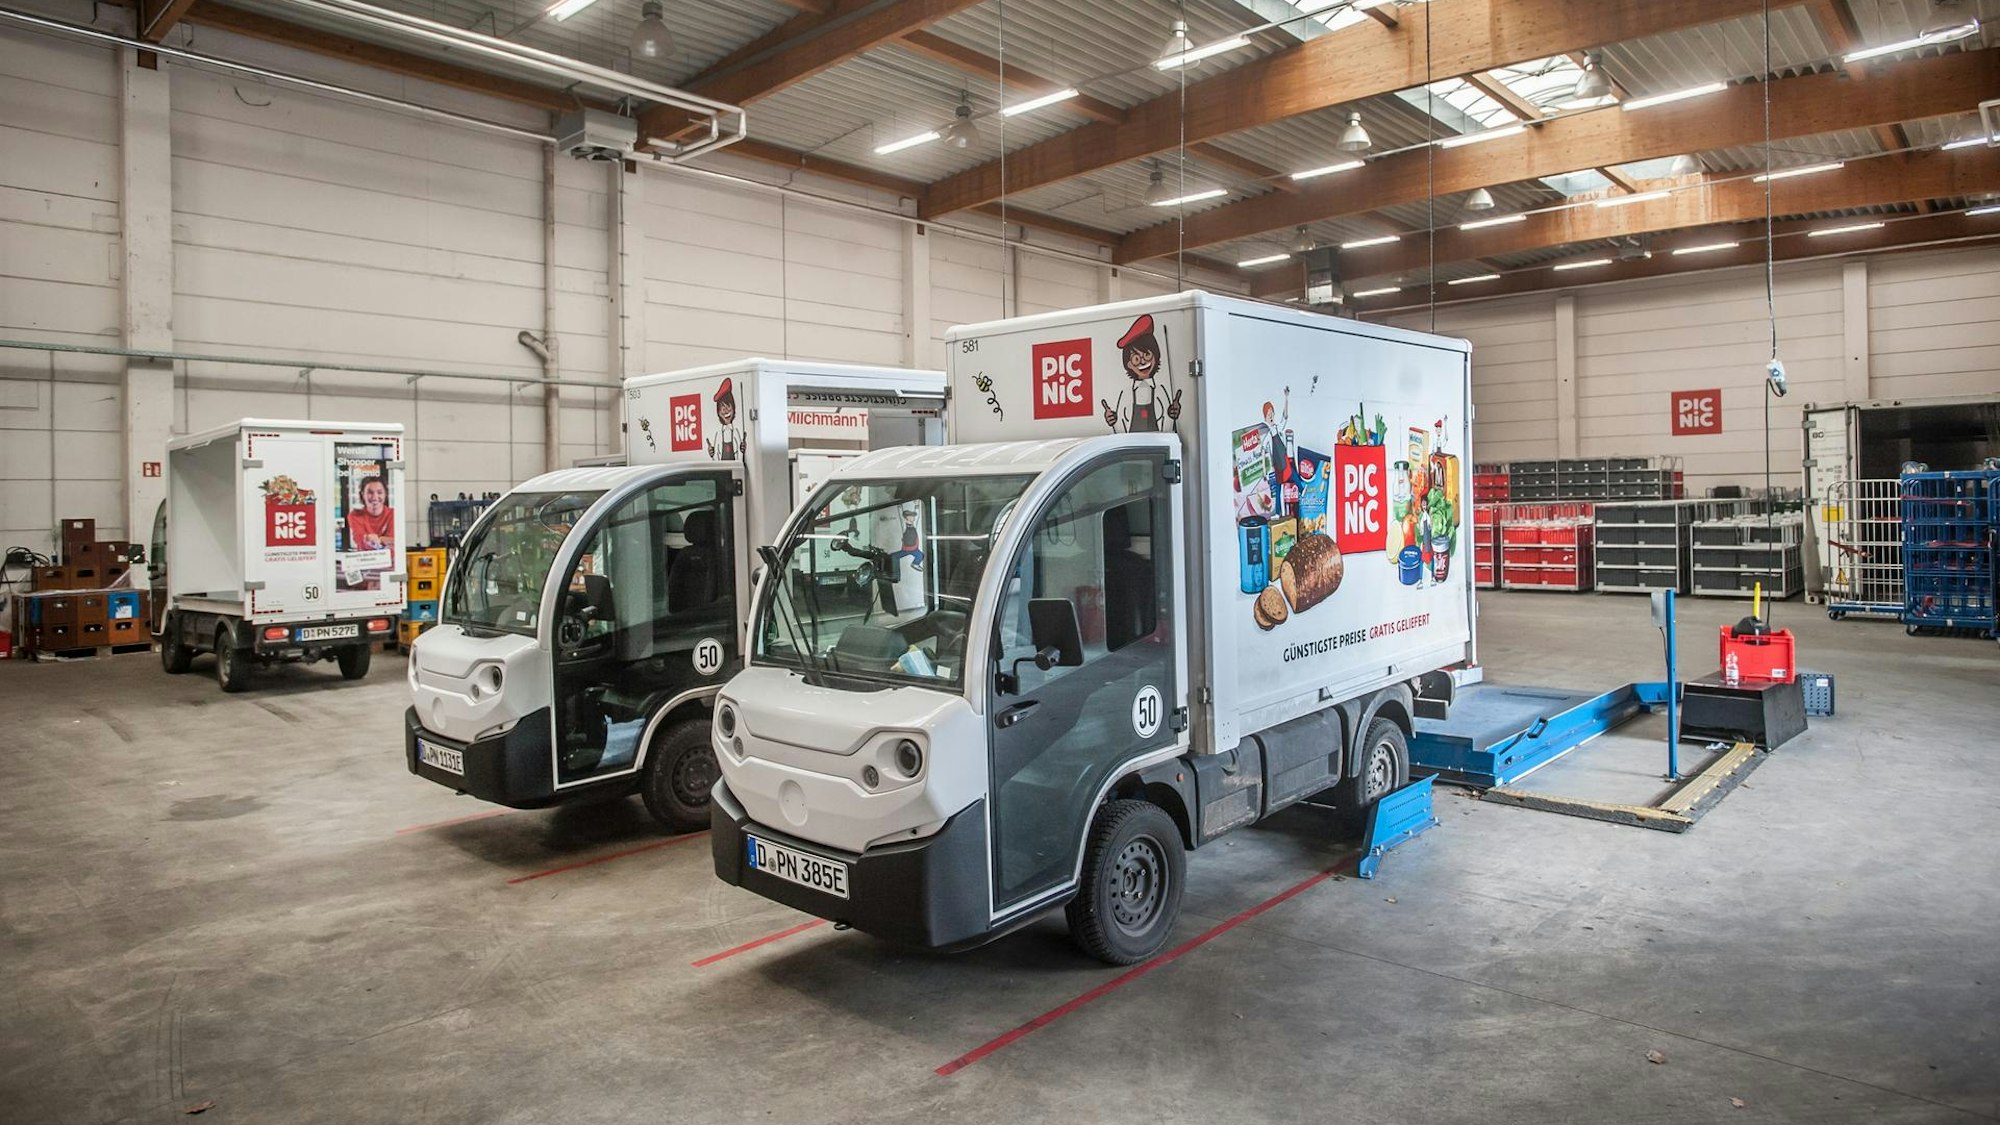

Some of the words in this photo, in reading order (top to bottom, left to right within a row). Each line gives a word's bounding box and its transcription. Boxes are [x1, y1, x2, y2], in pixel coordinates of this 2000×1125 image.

[962, 339, 979, 353] 581
[1041, 353, 1082, 380] PIC
[630, 389, 641, 400] 503
[674, 404, 697, 423] PIC
[1679, 398, 1713, 413] PIC
[337, 457, 375, 467] Shopper
[1344, 463, 1378, 497] PIC
[274, 511, 307, 525] PIC
[305, 586, 319, 600] 50
[303, 629, 310, 639] D
[317, 629, 330, 638] PN
[332, 625, 357, 636] 527E
[1283, 636, 1338, 662] GÜNSTIGSTE
[1339, 629, 1367, 648] PREISE
[1369, 622, 1395, 640] GRATIS
[1396, 613, 1430, 632] GELIEFERT
[700, 645, 717, 668] 50
[1139, 695, 1156, 729] 50
[440, 750, 462, 772] 1131E
[757, 843, 767, 867] D
[776, 850, 798, 880] PN
[801, 858, 846, 894] 385E
